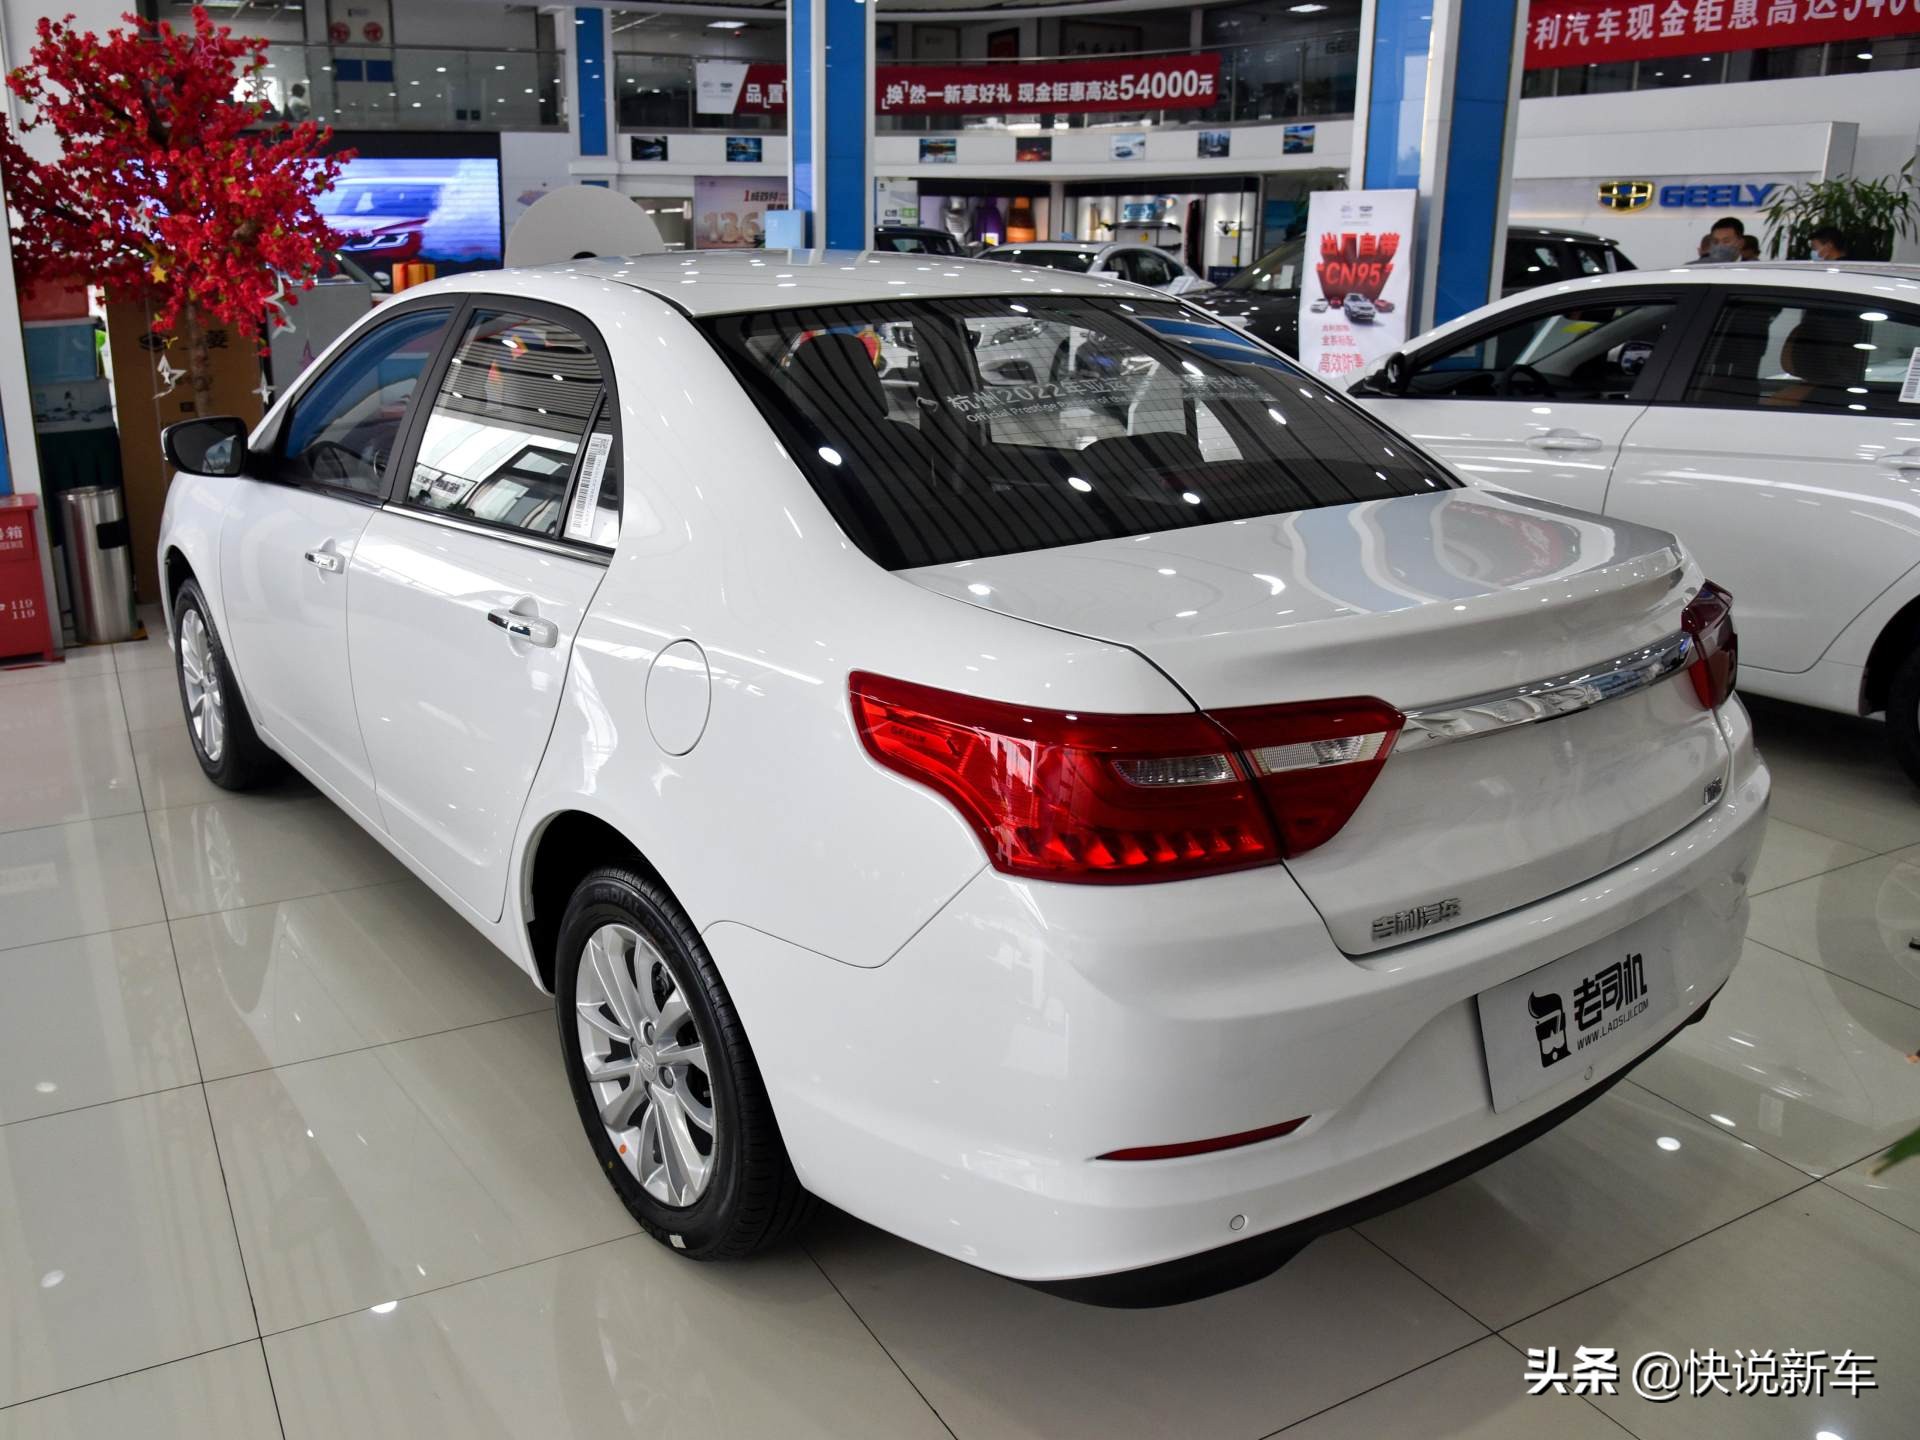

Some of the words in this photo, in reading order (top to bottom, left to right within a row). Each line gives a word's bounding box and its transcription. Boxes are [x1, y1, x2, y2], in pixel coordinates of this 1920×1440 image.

[1018, 70, 1213, 103] 现金钜惠高达54000元
[1659, 184, 1776, 207] GEELY
[1573, 952, 1648, 1031] 老司机
[1577, 998, 1649, 1050] WWW.LAOSIJI.COM
